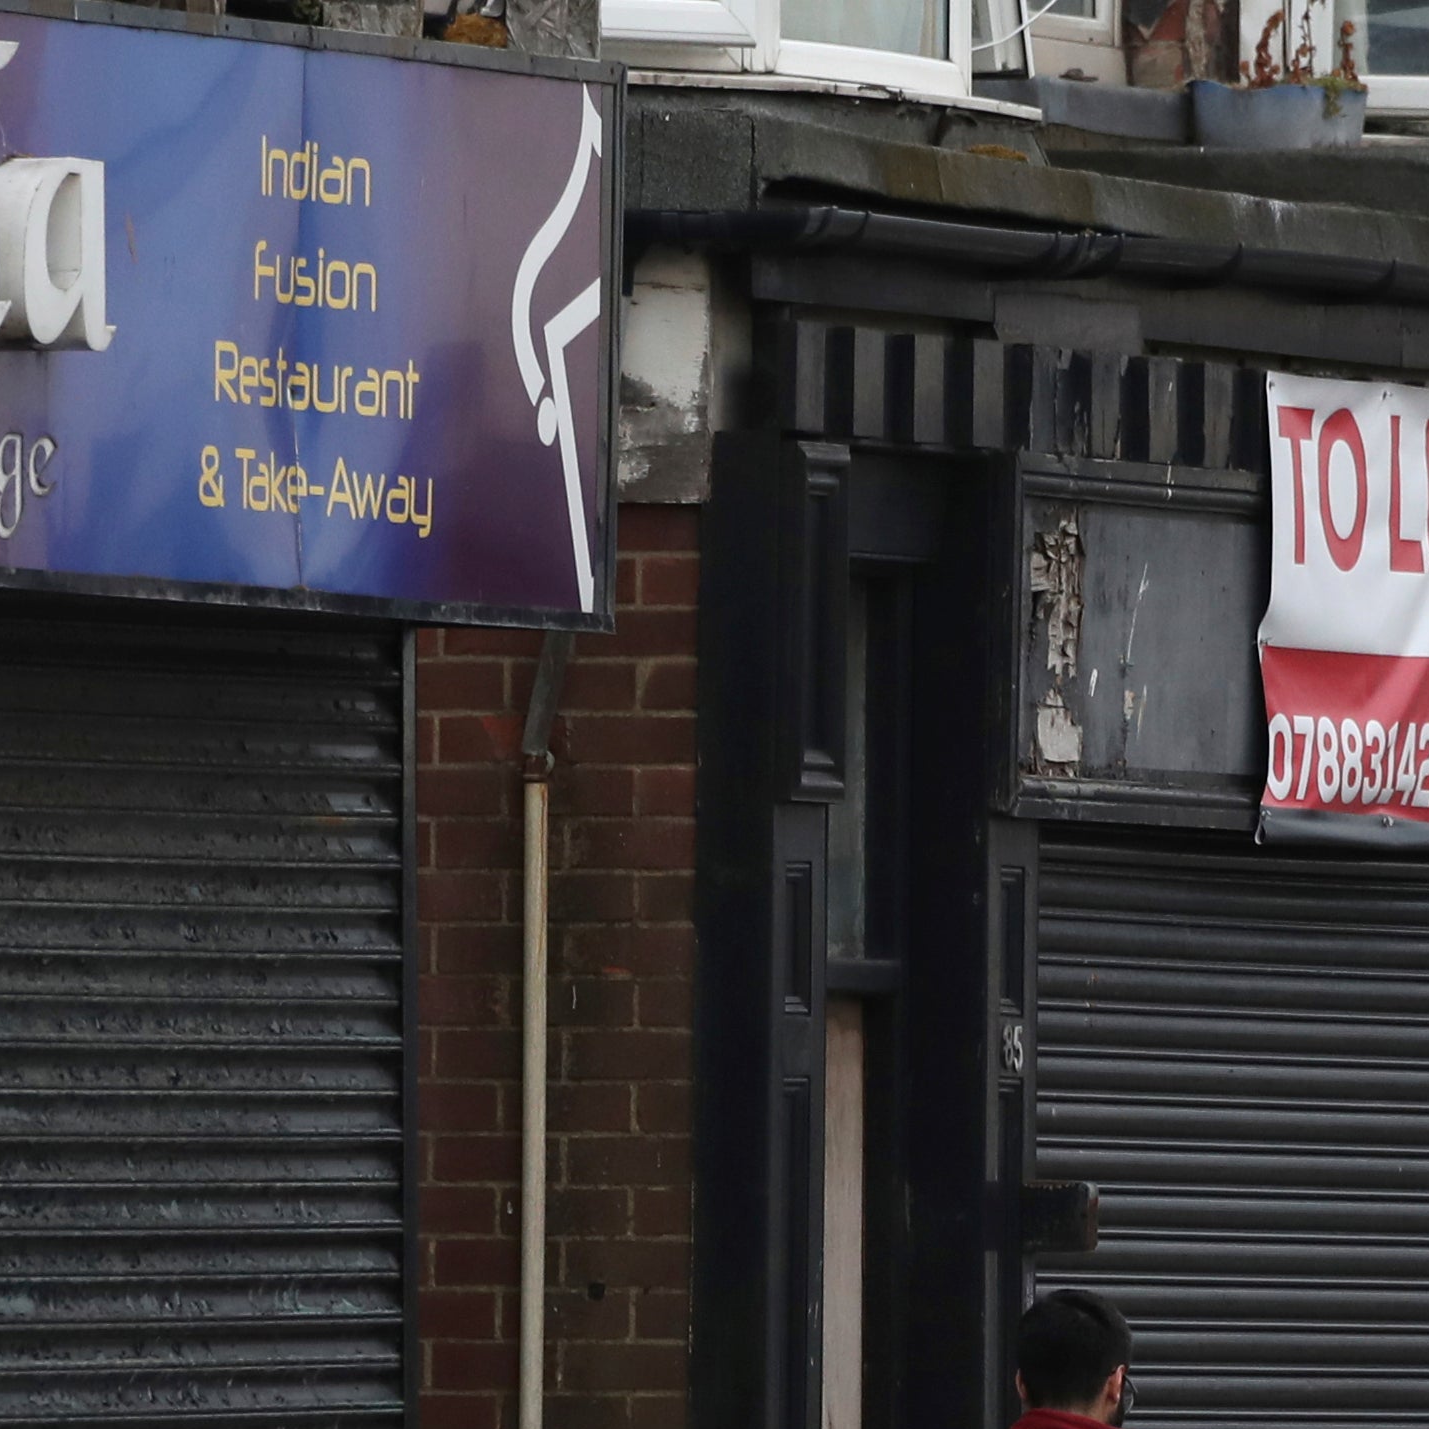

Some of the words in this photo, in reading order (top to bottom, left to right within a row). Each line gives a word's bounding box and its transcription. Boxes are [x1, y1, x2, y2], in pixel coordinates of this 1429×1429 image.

[261, 134, 371, 207] Indian
[214, 340, 420, 421] Restaurant
[198, 445, 225, 508] &
[235, 447, 433, 539] Take-Away
[1277, 407, 1368, 573] TO
